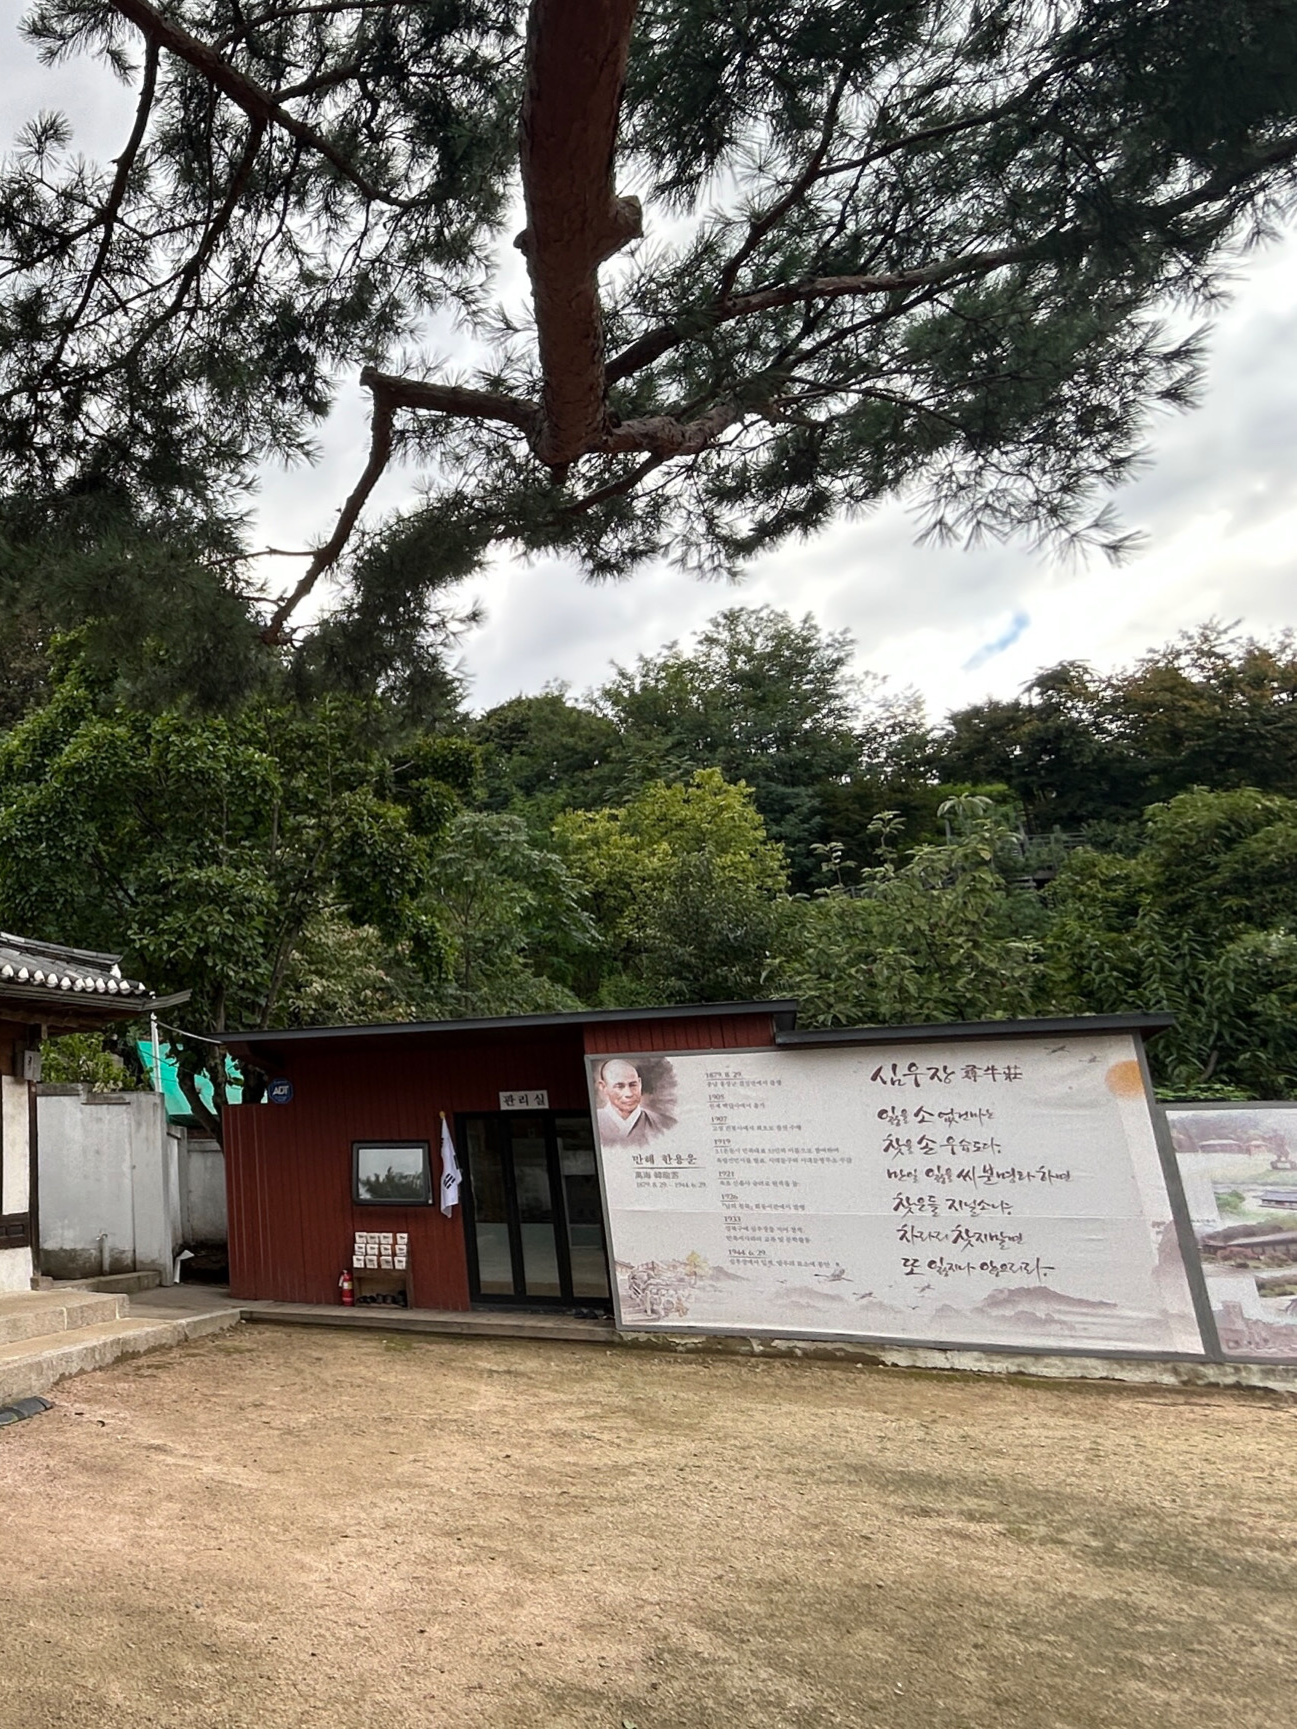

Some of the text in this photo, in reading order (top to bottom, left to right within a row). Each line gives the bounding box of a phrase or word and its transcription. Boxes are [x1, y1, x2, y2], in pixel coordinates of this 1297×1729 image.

[870, 1062, 955, 1088] 심우장
[272, 1085, 289, 1096] ADT
[502, 1093, 546, 1106] 관리실
[913, 1105, 935, 1124] 소
[632, 1153, 698, 1165] 만해 한용운
[896, 1224, 949, 1245] 차라리
[901, 1256, 926, 1276] 또
